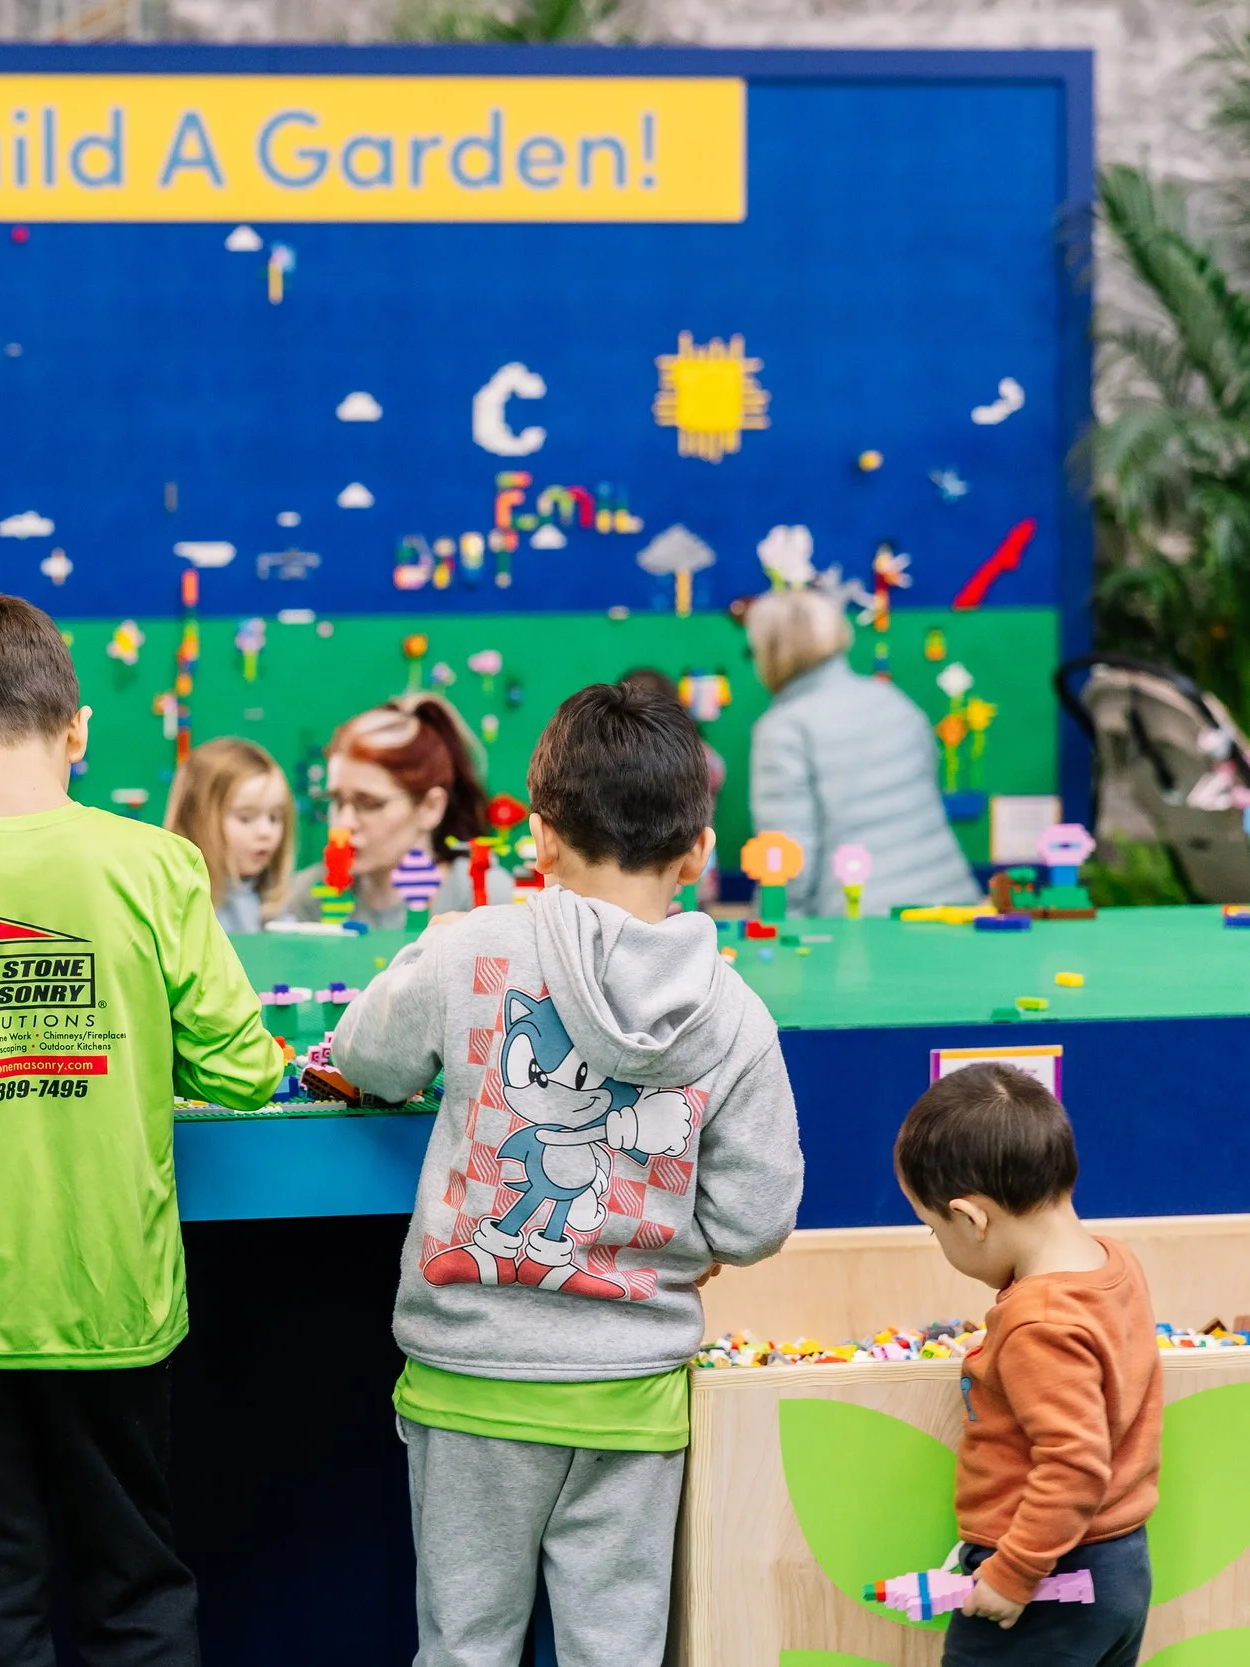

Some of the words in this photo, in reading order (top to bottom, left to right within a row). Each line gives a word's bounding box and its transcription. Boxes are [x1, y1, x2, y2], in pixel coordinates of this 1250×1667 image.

[157, 109, 227, 188] A
[256, 108, 656, 189] Garden!
[2, 959, 86, 979] STONE
[9, 1031, 32, 1041] Work
[39, 1042, 74, 1051] Outdoor
[77, 1042, 111, 1051] Kitchens
